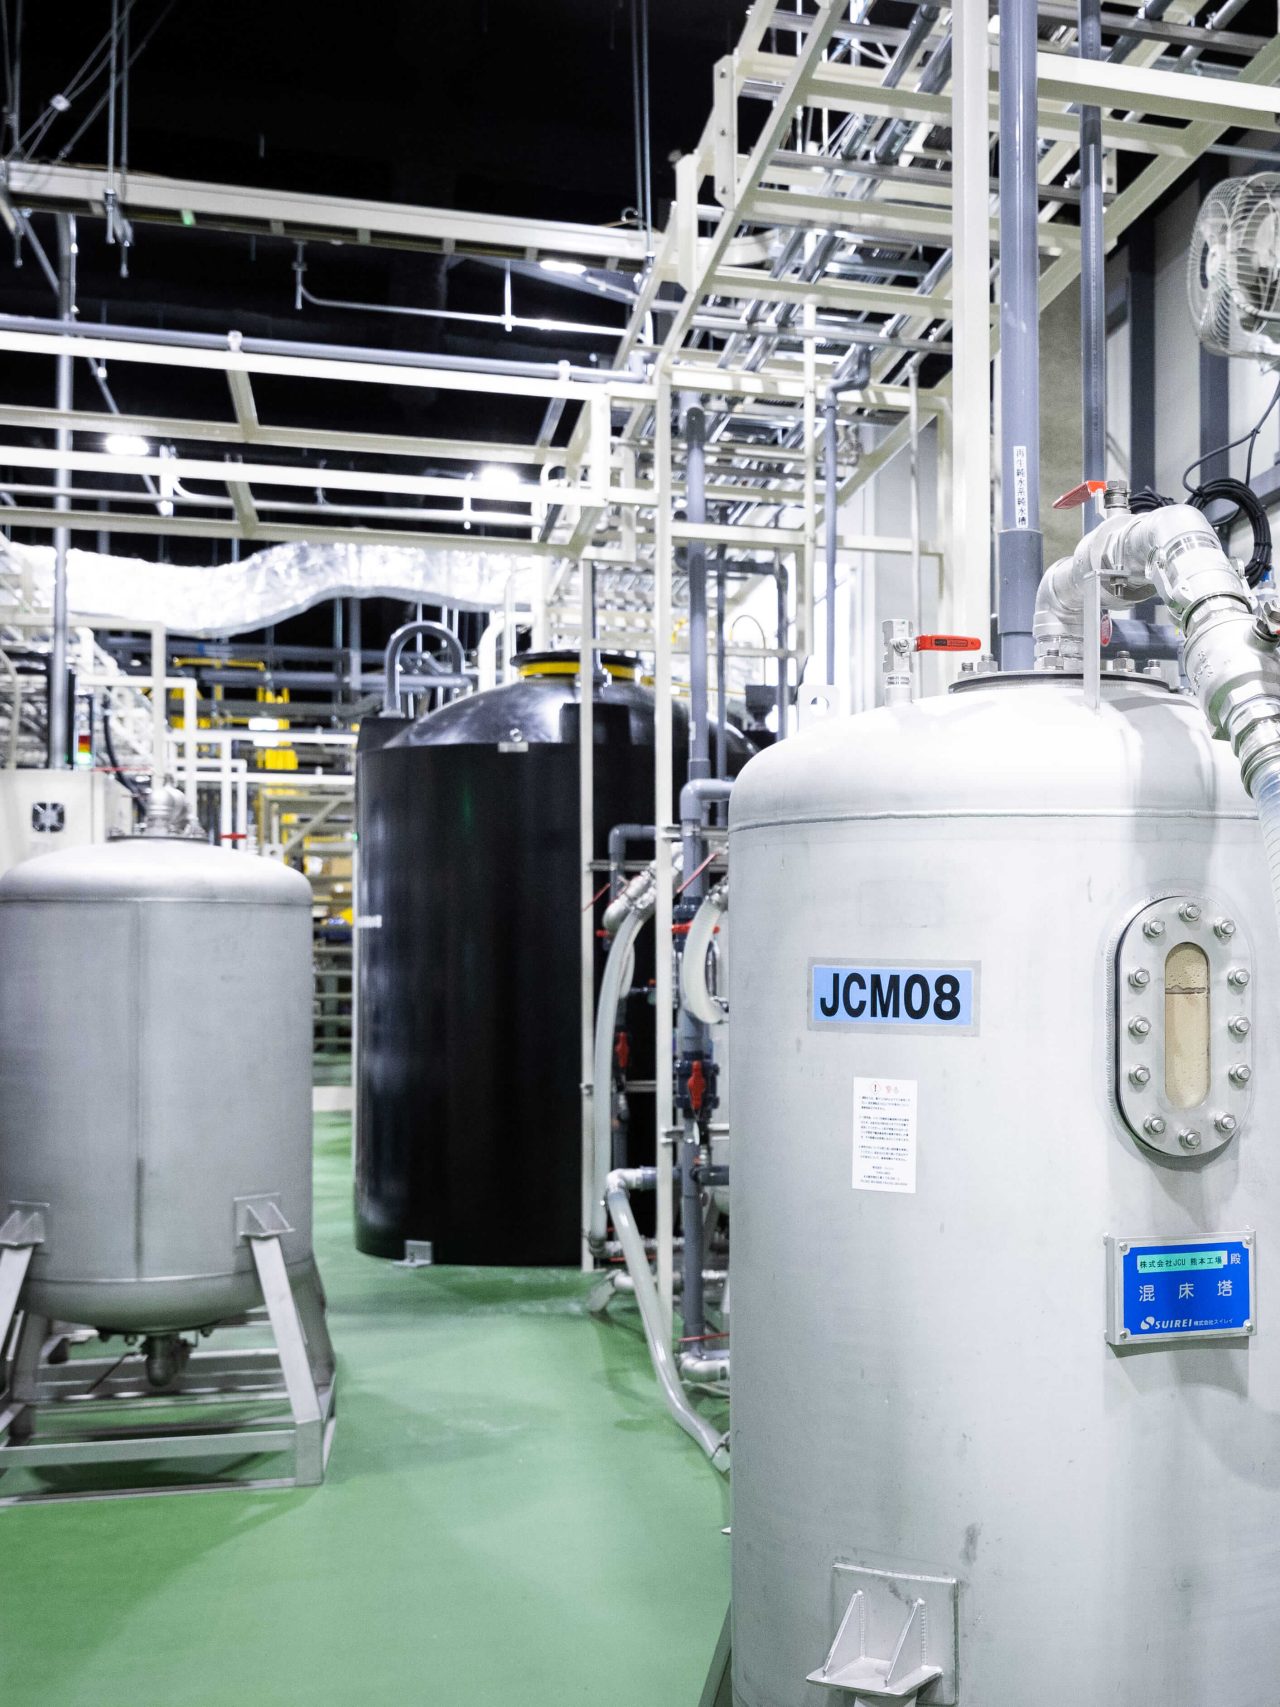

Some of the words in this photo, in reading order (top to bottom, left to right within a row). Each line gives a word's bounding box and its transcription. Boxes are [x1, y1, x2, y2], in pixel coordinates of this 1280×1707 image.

[820, 972, 961, 1021] JCM08
[1139, 1258, 1186, 1268] 株式会社JCU
[1190, 1256, 1223, 1266] 熊本工場
[1155, 1318, 1193, 1330] SUIREI
